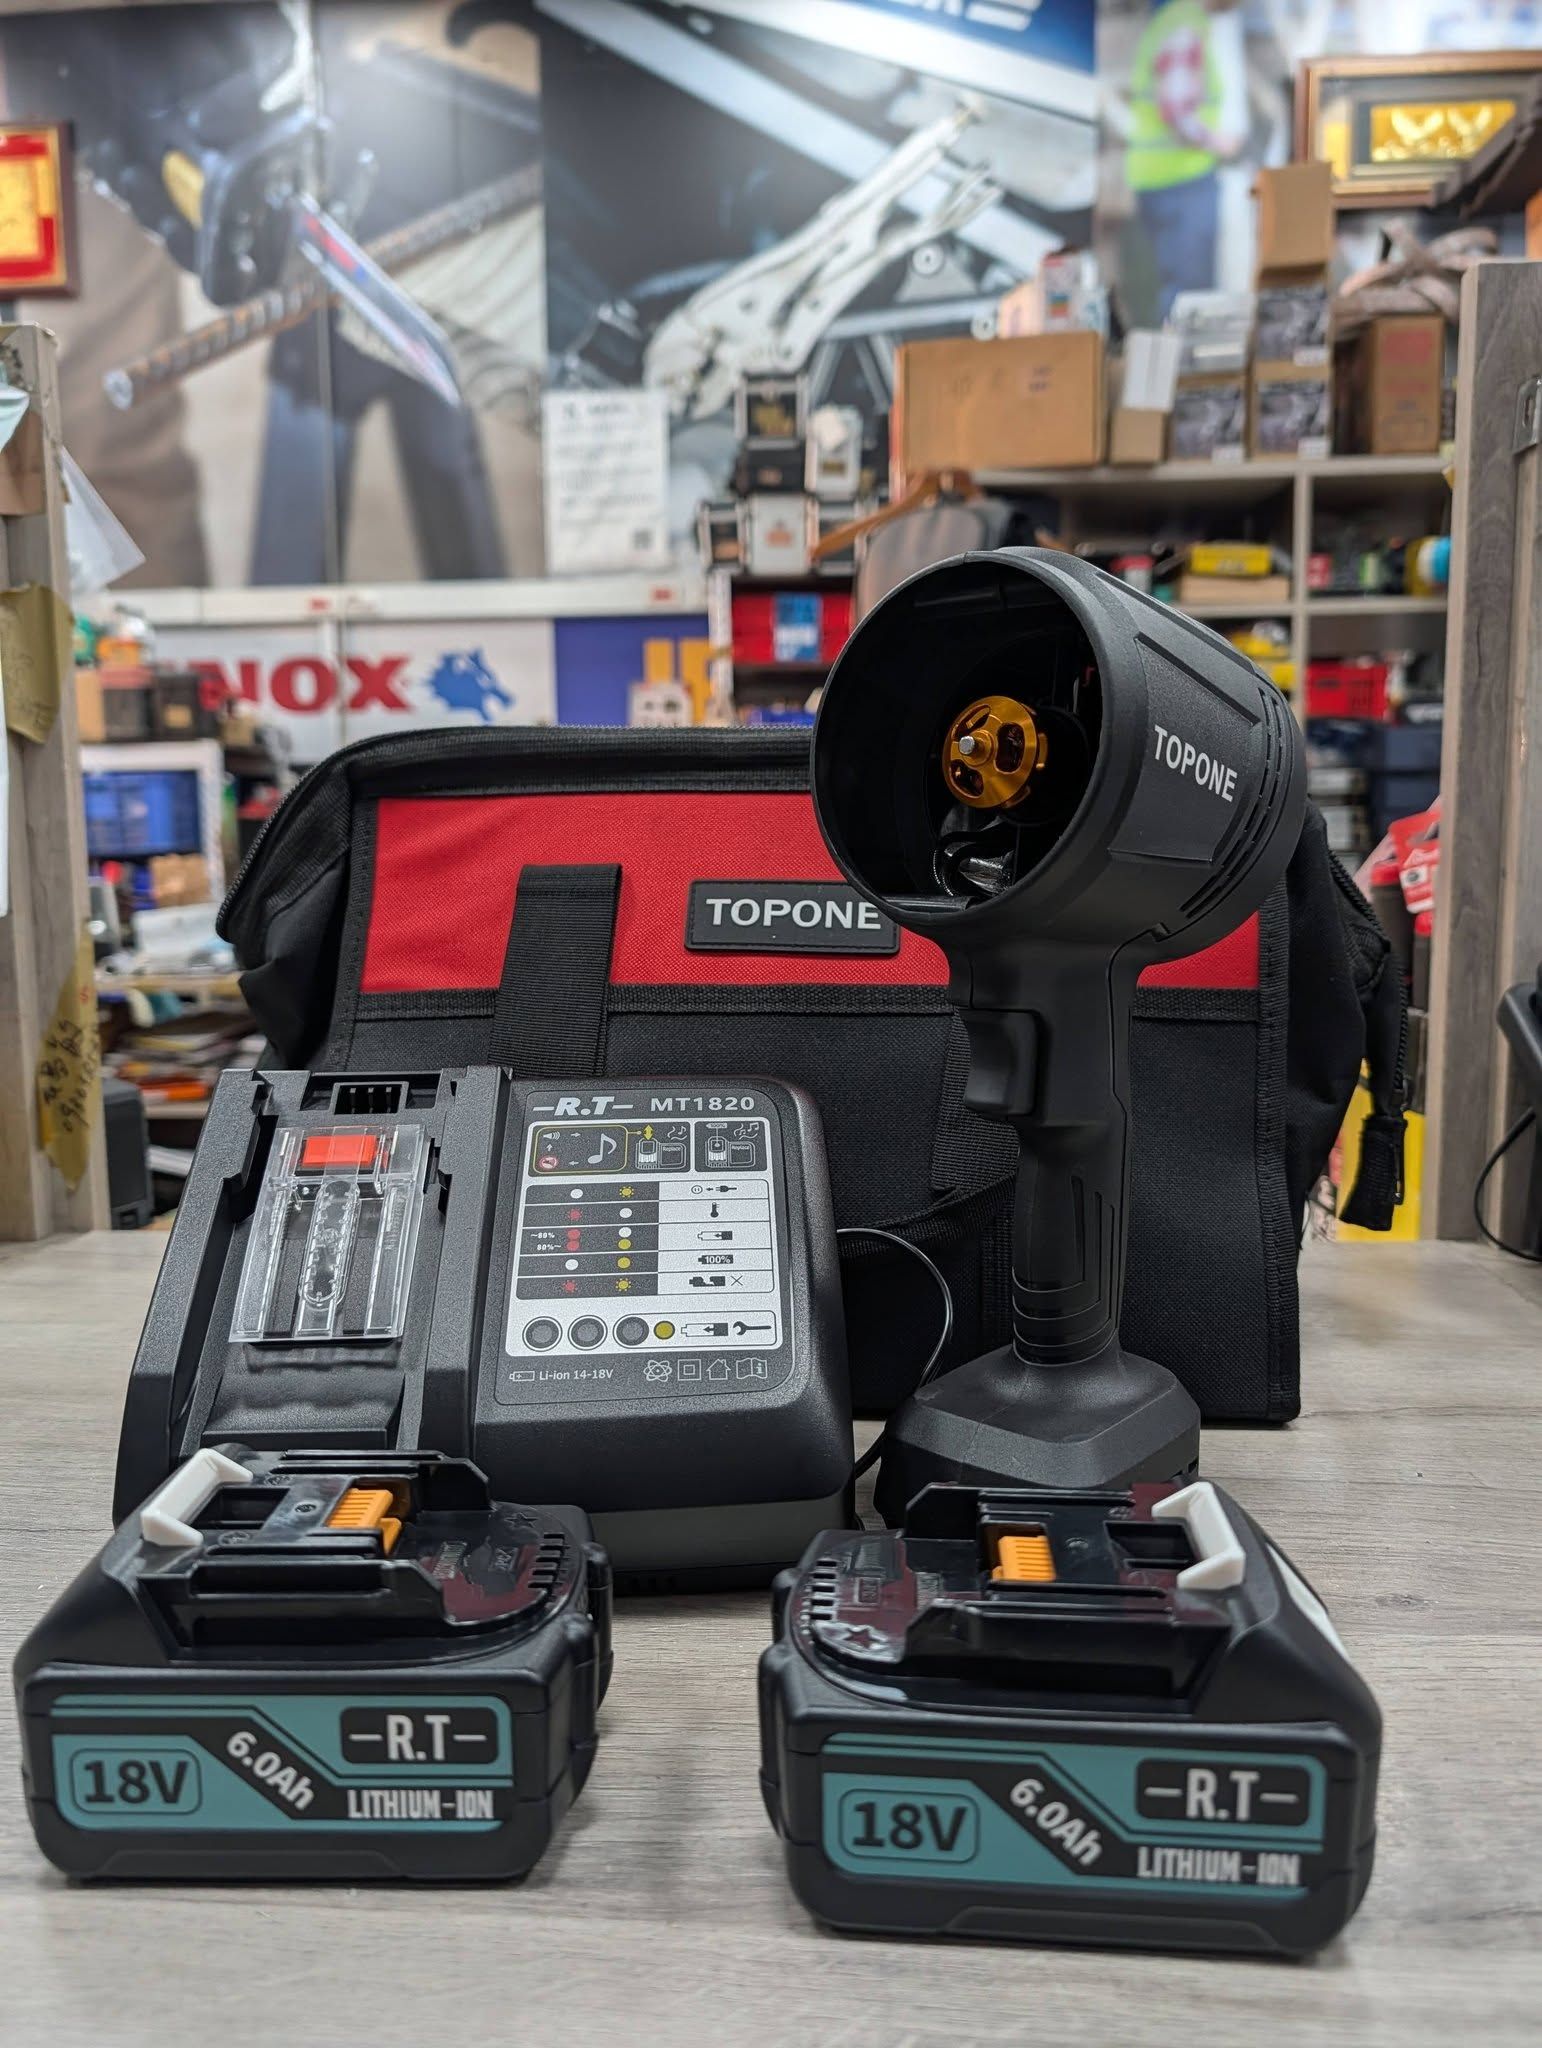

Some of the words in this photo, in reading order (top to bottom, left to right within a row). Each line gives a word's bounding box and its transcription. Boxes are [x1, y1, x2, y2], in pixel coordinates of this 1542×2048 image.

[1155, 724, 1238, 802] TOPONE
[706, 898, 881, 930] TOPONE
[651, 1096, 755, 1112] MT1820
[704, 1255, 731, 1264] 100%
[539, 1370, 570, 1380] Li-ion
[574, 1368, 614, 1380] 14-18V
[83, 1759, 190, 1804] 18V
[227, 1730, 314, 1810] 6.0Ah
[347, 1790, 495, 1820] LITHIUM-ION
[1010, 1777, 1103, 1866] 6.0Ah
[852, 1801, 967, 1852] 18V
[1137, 1847, 1301, 1886] LITHIUM-ION
